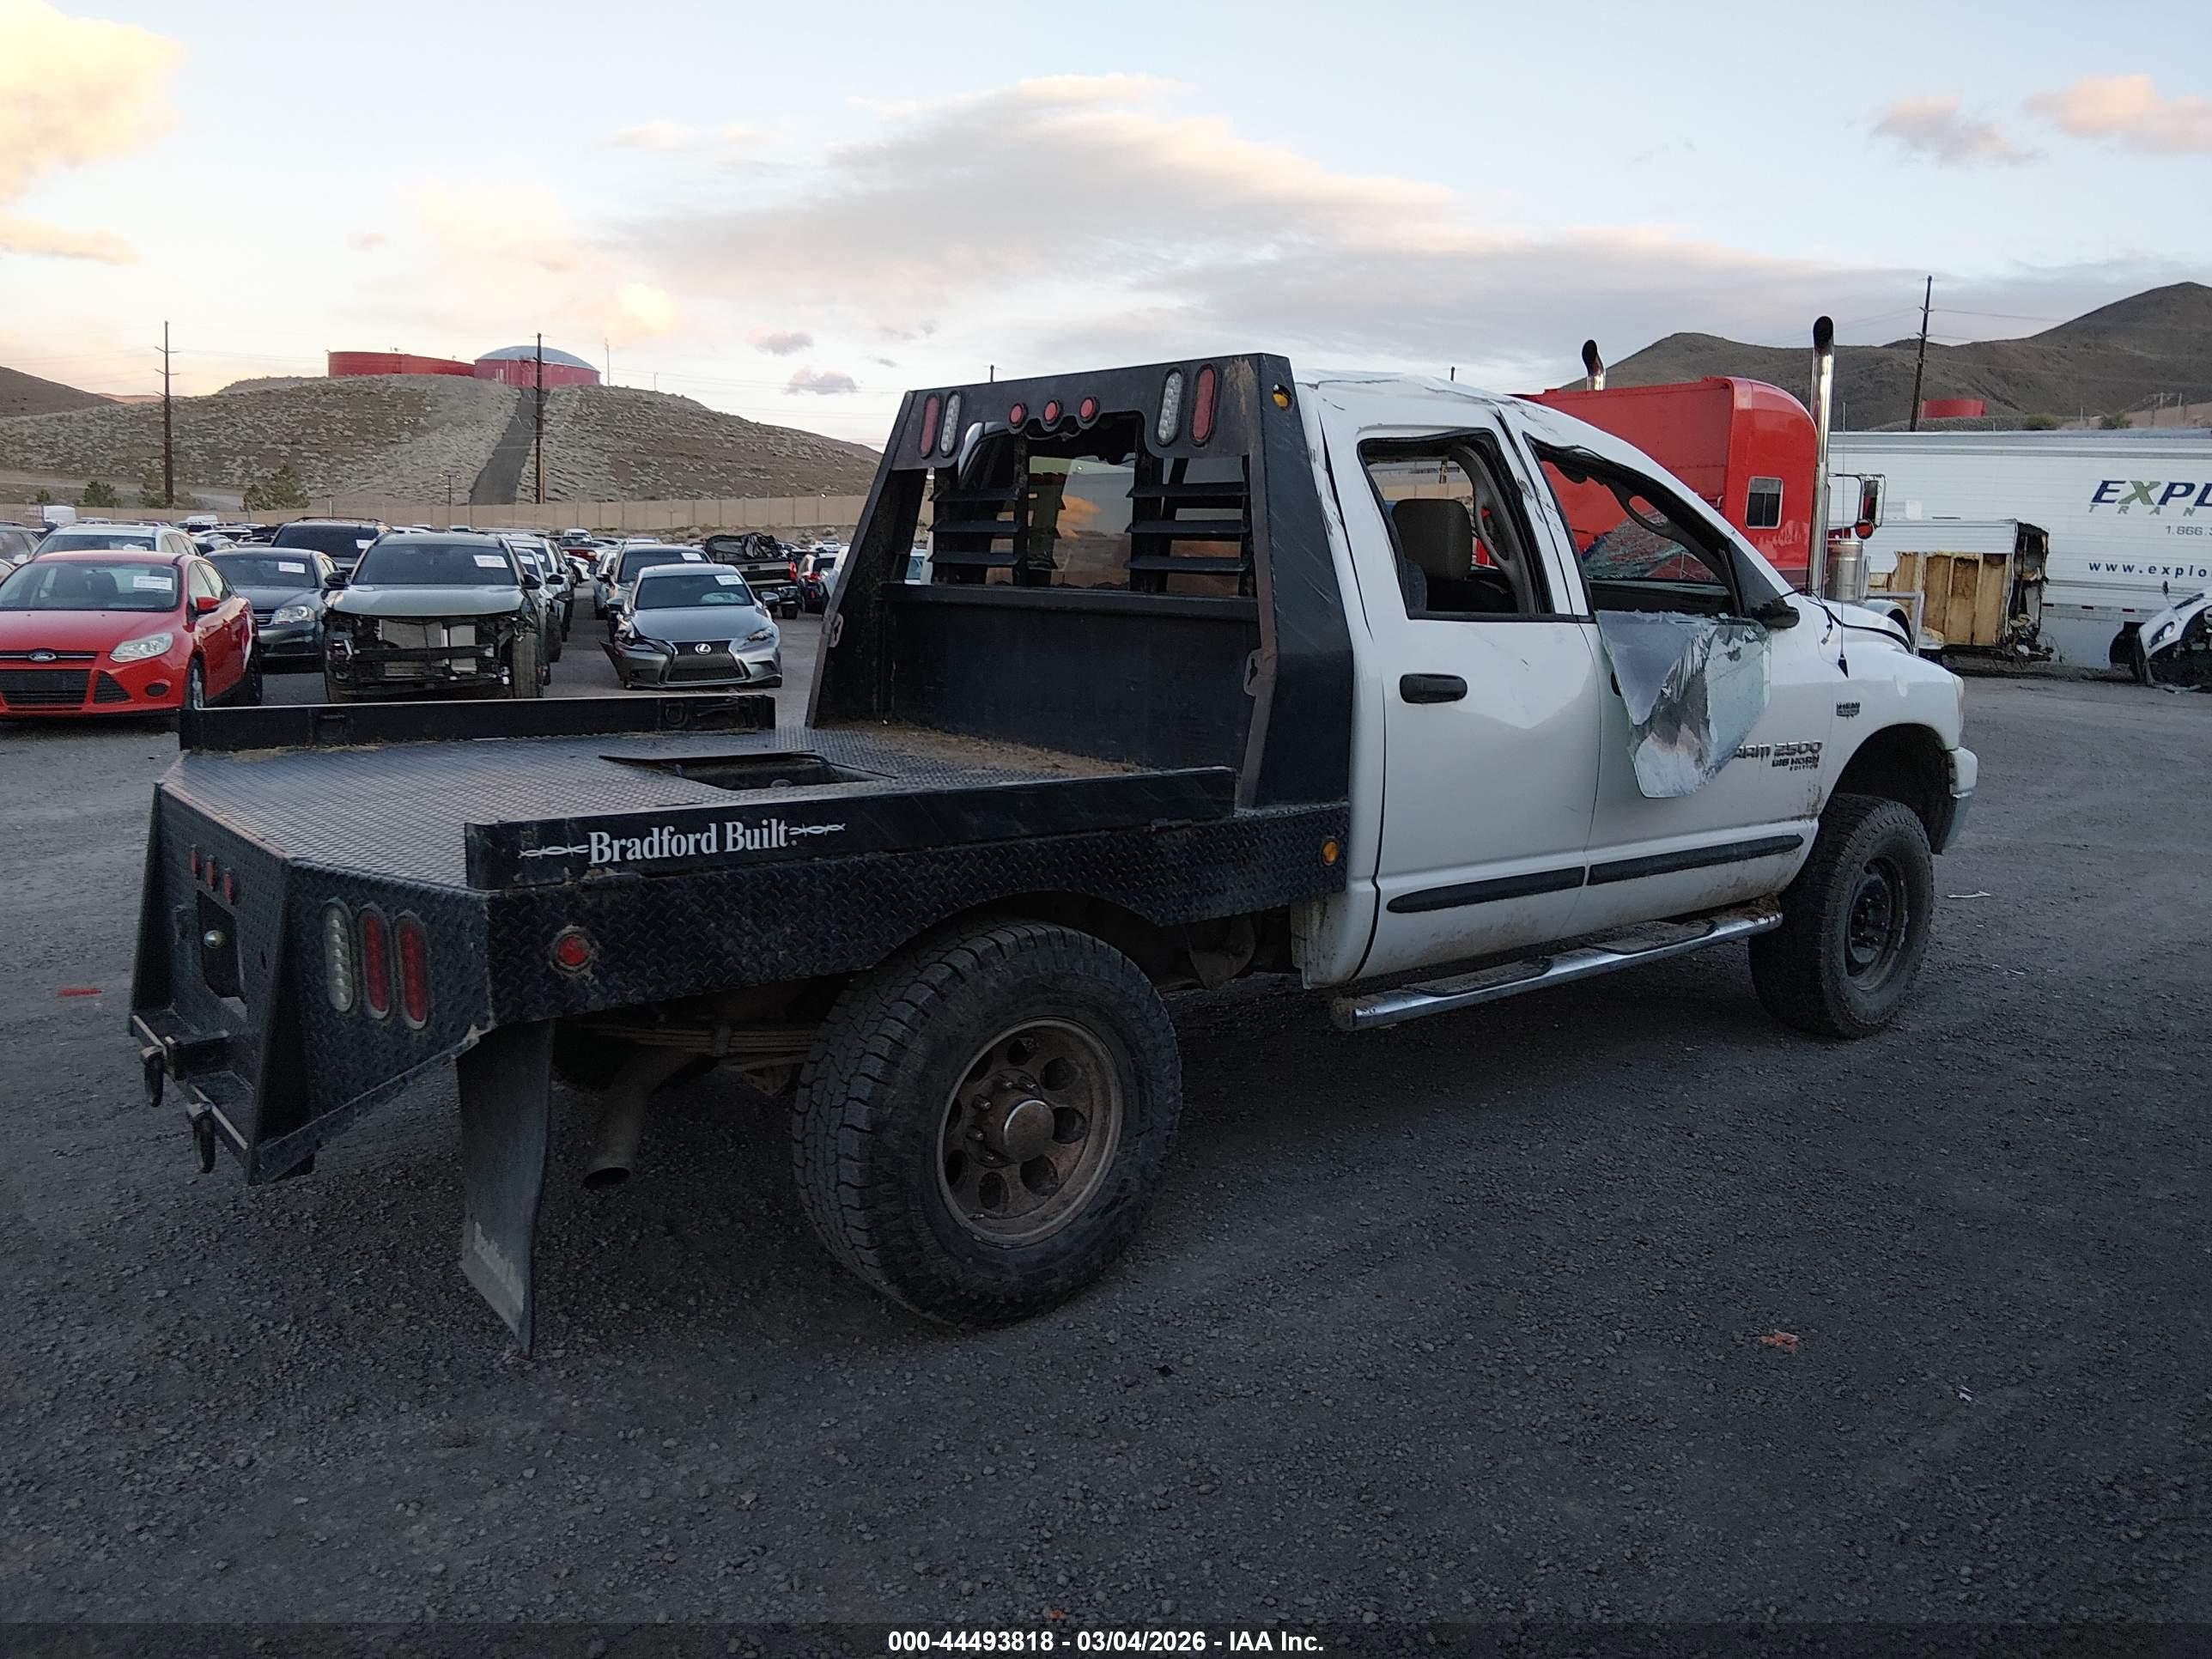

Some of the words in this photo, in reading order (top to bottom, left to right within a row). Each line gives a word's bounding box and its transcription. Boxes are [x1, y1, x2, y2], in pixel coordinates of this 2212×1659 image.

[2088, 562, 2212, 579] www.explo
[1774, 741, 1822, 757] 2500
[1772, 758, 1790, 767] BIG
[1790, 755, 1820, 765] HORN
[588, 823, 719, 864] Bradford
